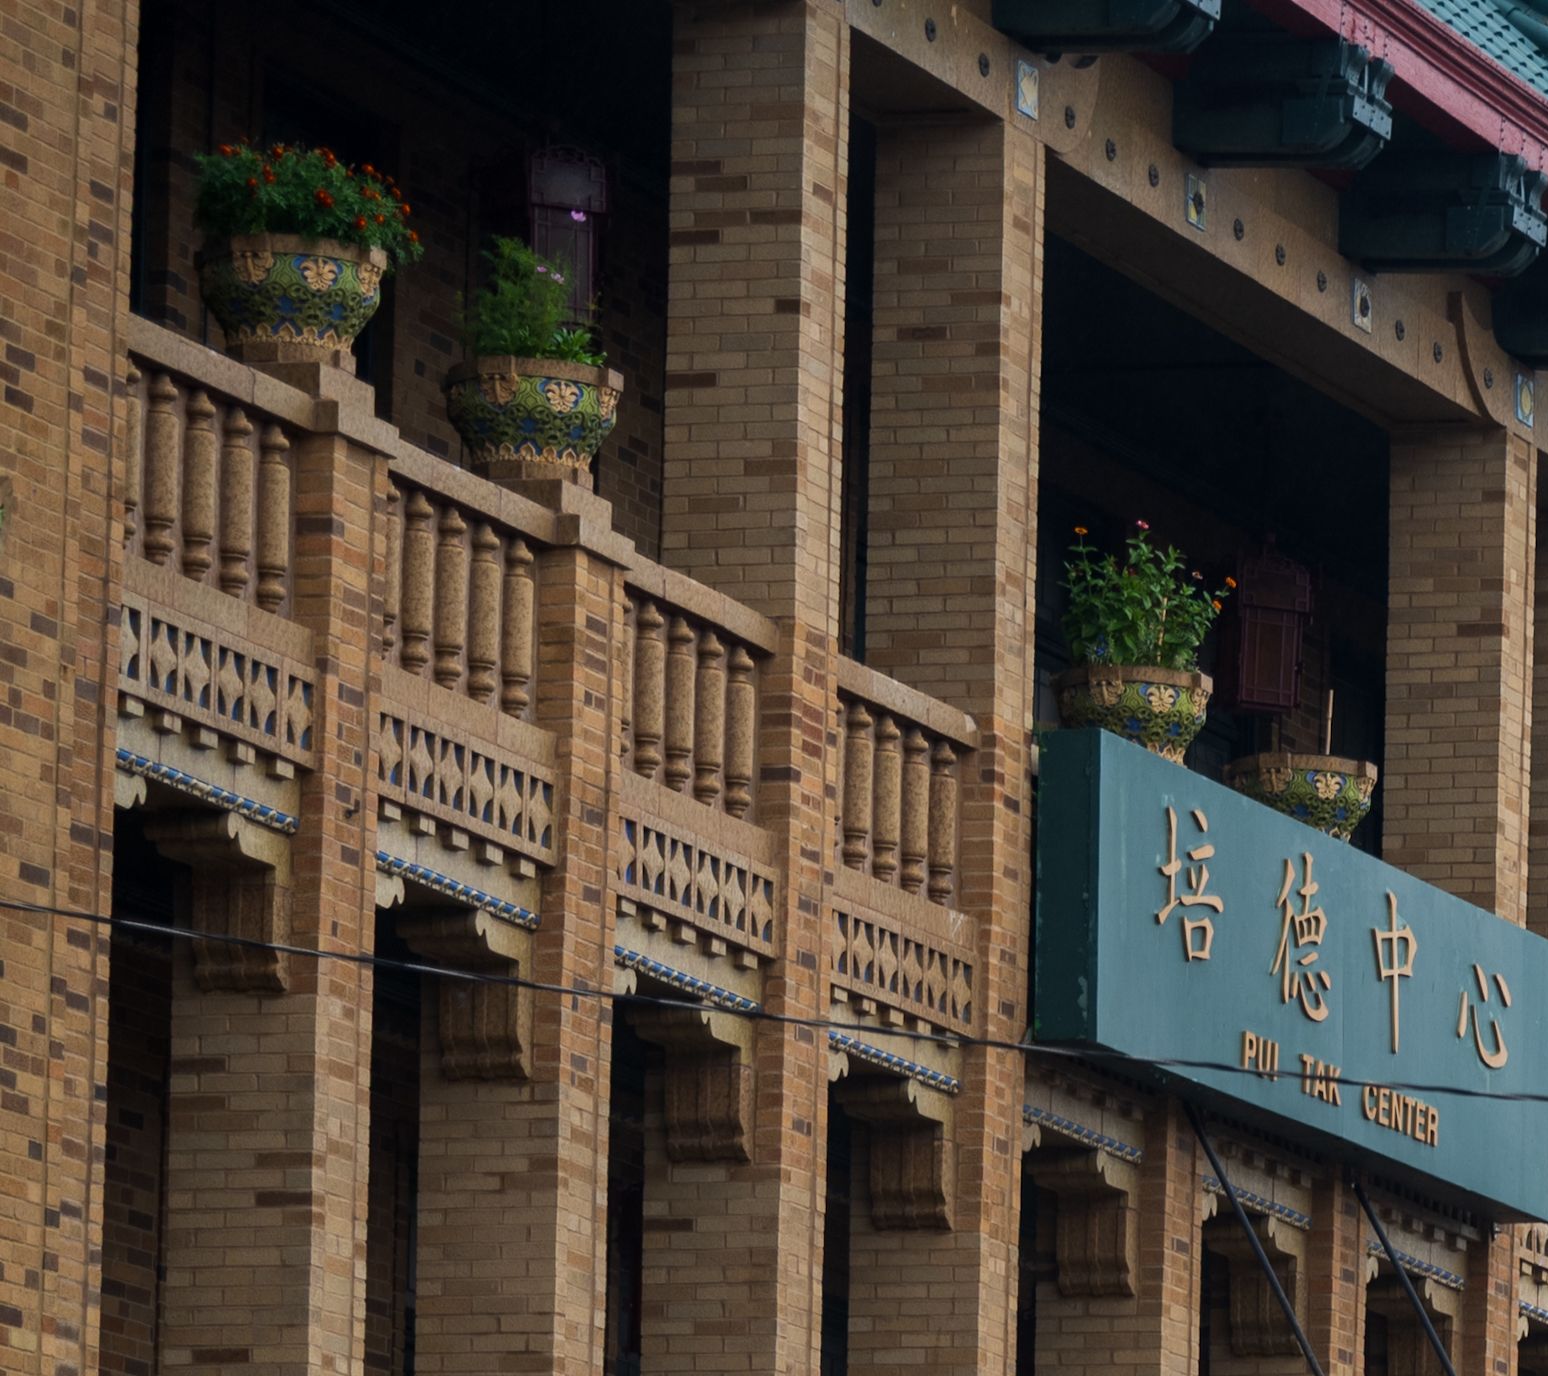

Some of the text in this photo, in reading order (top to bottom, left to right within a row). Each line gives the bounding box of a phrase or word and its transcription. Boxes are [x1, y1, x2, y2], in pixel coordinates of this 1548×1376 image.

[1154, 805, 1512, 1070] 培德中心
[1241, 1031, 1439, 1147] PUI TAK CENTER
